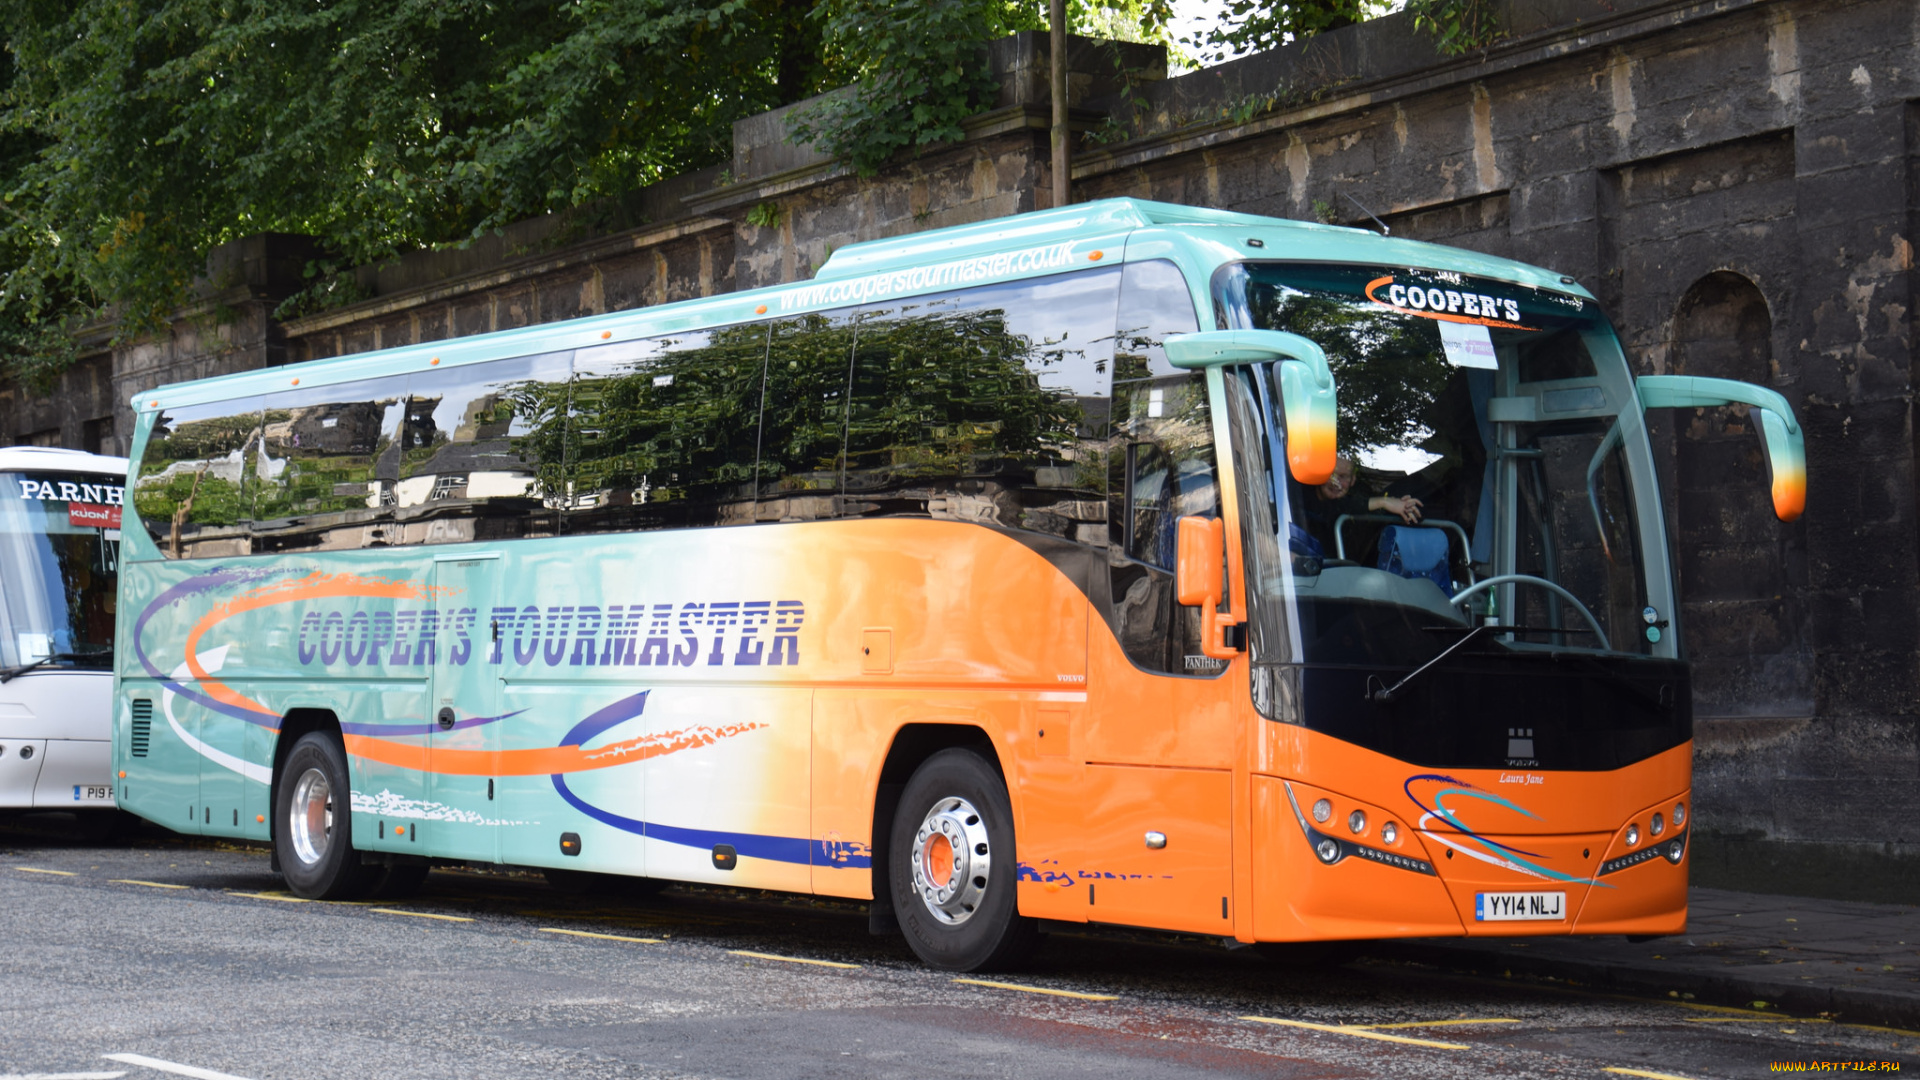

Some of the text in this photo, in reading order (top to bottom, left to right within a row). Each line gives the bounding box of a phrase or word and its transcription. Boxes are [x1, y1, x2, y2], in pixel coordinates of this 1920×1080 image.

[1389, 284, 1521, 322] COOPER'S
[19, 480, 125, 505] PARNH
[298, 600, 805, 666] COOPER'S TOURMASTER
[1057, 674, 1084, 682] VOLVO
[1499, 772, 1544, 786] Laura Jane
[87, 787, 106, 799] P19
[1490, 895, 1560, 915] YY14 NLJ
